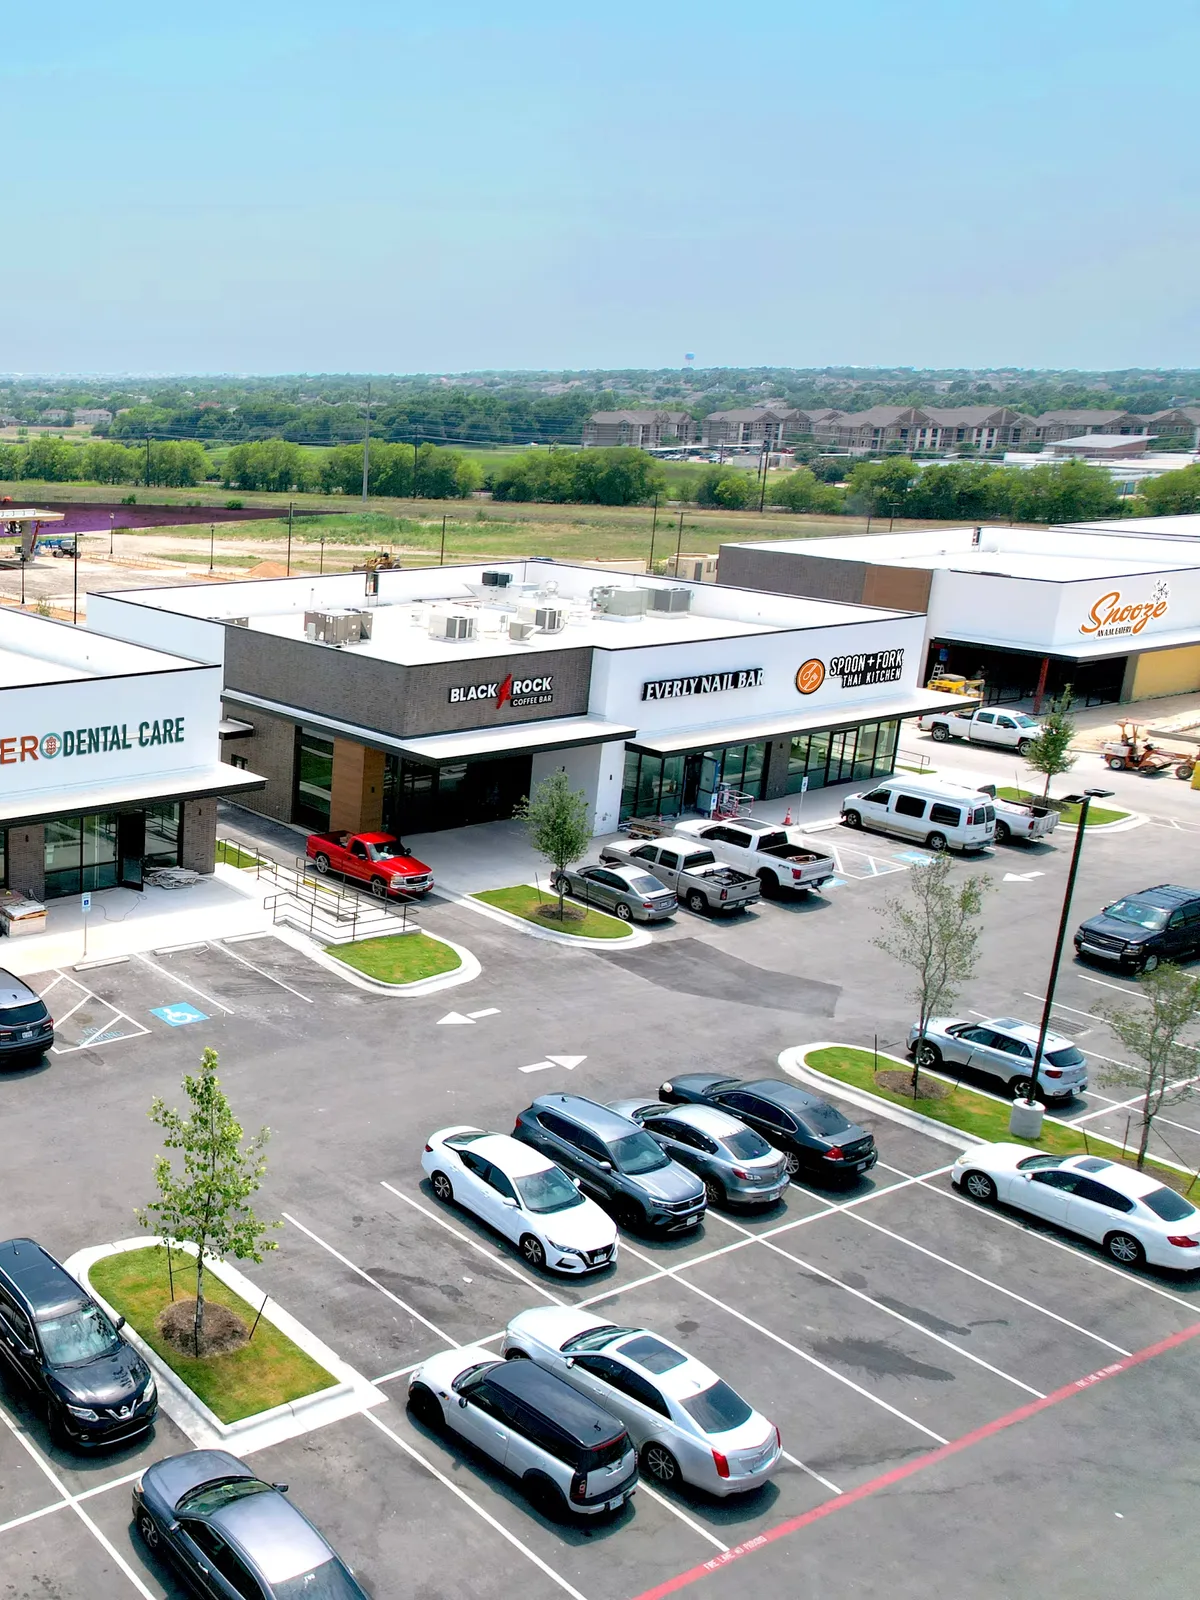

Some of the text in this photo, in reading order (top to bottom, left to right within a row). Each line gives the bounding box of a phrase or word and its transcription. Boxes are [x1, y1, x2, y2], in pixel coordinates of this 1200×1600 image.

[1081, 592, 1168, 635] Snooze
[830, 655, 867, 676] SPOON
[876, 649, 904, 669] FORK
[450, 676, 553, 702] BLACK ROCK
[645, 669, 765, 700] EVERLY NAIL BAR
[843, 668, 901, 687] THAI KITCHEN
[512, 695, 553, 706] COFFEE BAR
[63, 724, 132, 757] DENTAL
[138, 717, 186, 747] CARE
